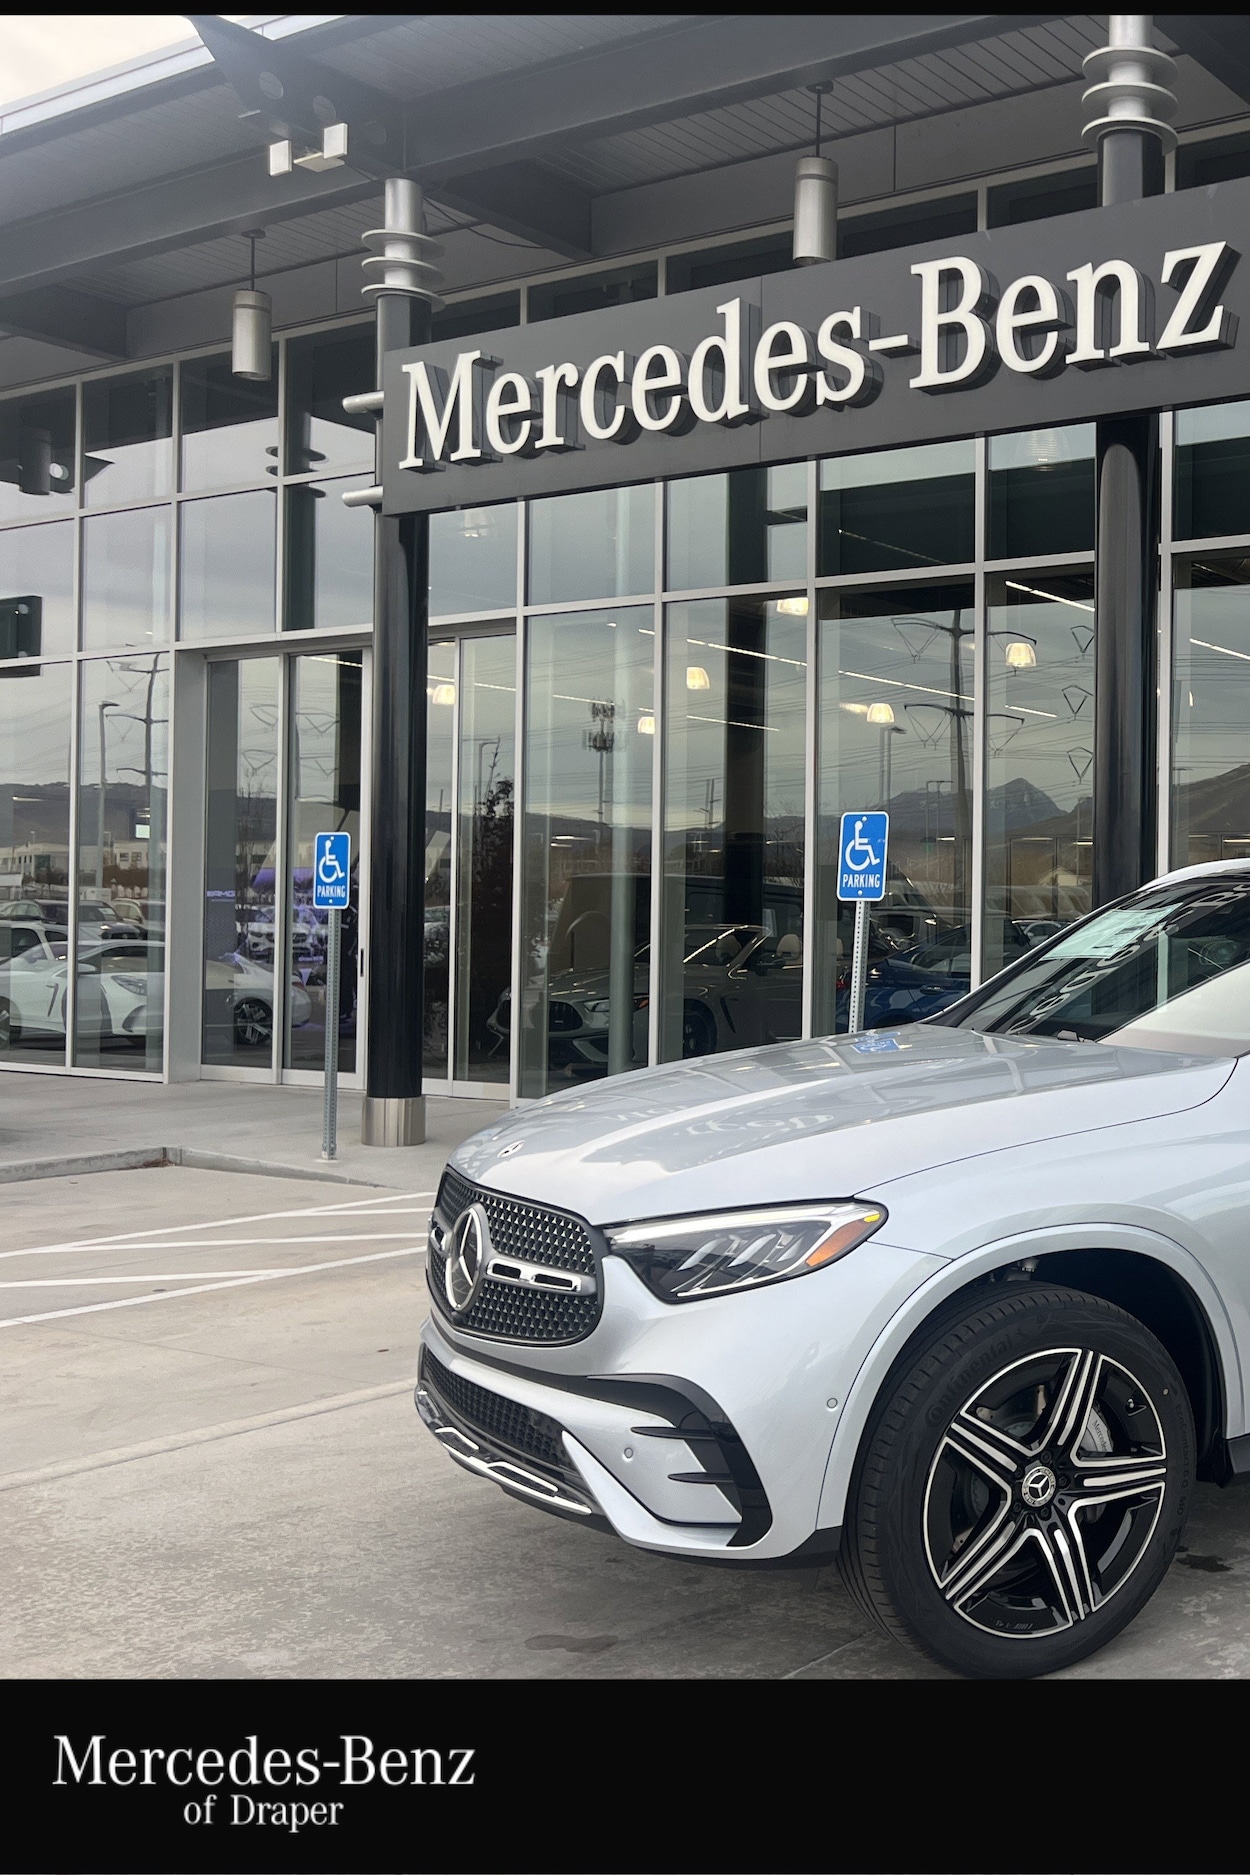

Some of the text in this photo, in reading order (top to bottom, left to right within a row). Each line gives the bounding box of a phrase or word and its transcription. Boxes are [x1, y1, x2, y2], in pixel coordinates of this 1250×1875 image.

[398, 240, 1230, 471] Mercedes-Benz
[317, 884, 346, 898] PARKING
[842, 873, 881, 888] PARKING
[925, 1332, 1014, 1428] Continental
[1175, 1403, 1190, 1468] EcoContact
